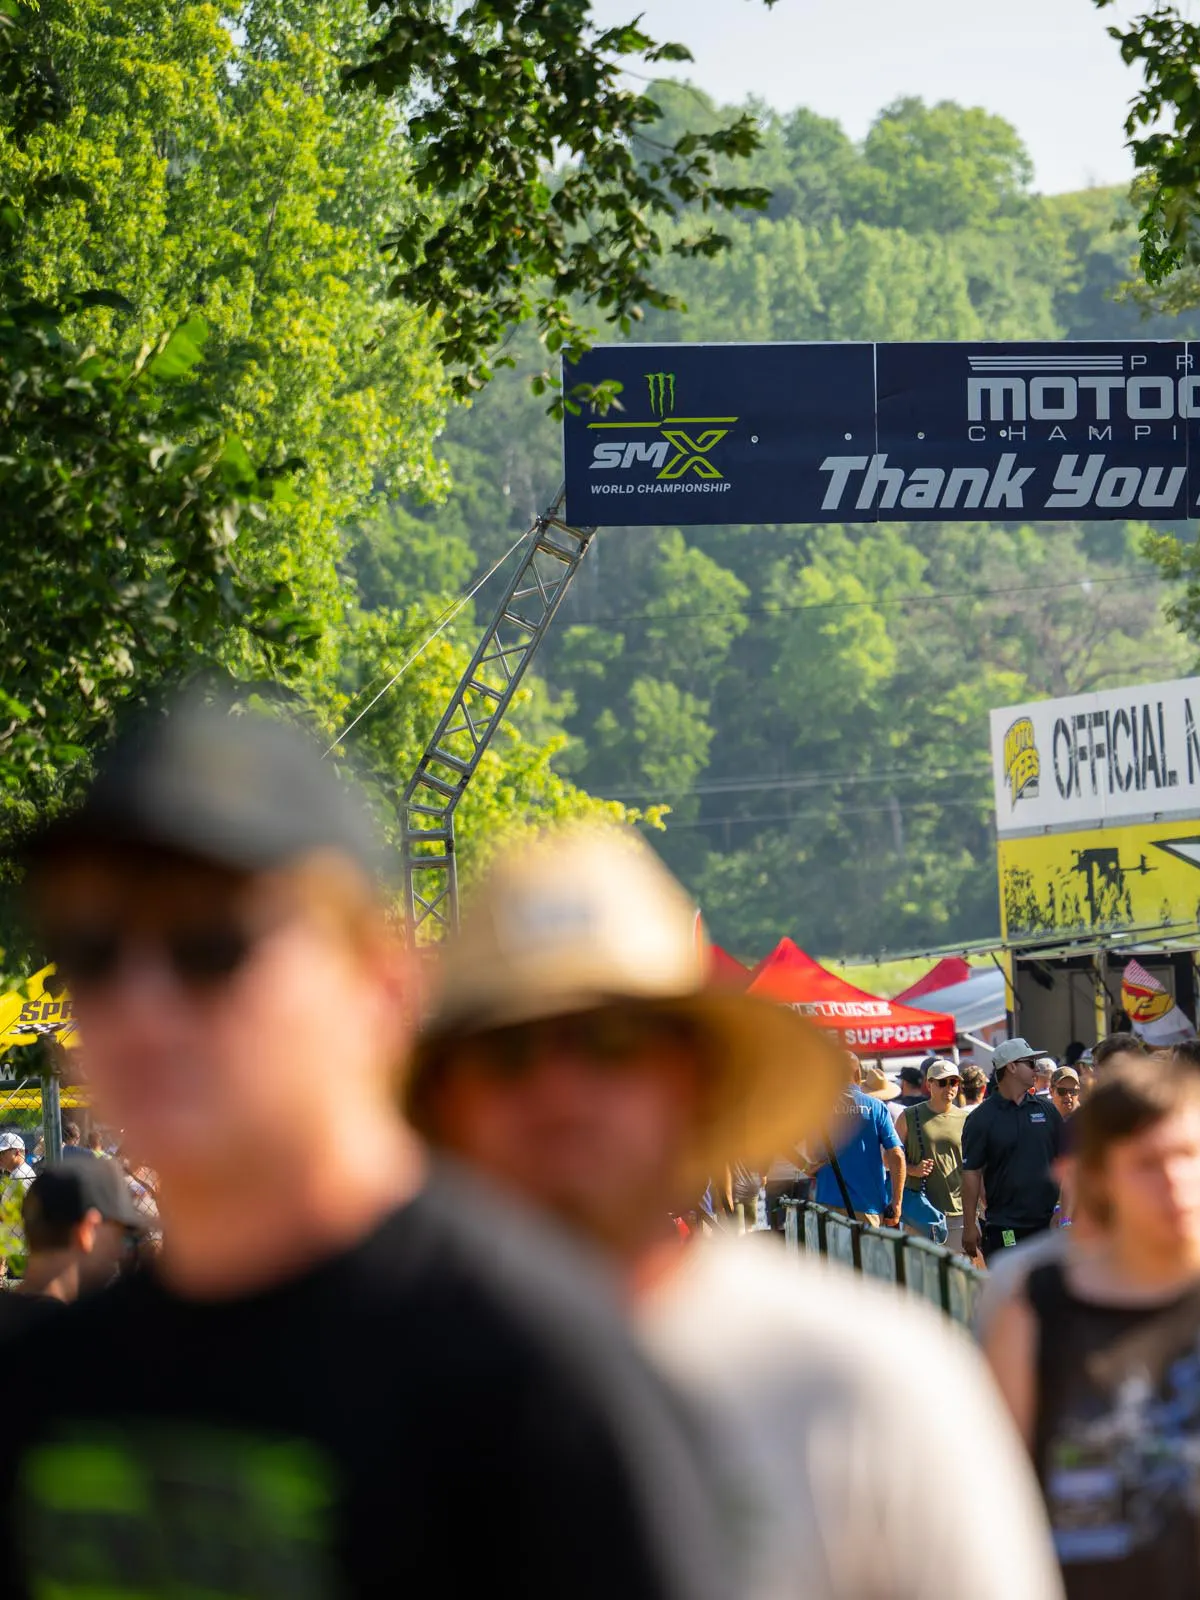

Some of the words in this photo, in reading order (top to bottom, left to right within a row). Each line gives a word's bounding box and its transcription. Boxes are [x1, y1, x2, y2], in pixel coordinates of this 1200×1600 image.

[588, 430, 729, 480] SMX
[818, 453, 1036, 510] Thank
[1044, 454, 1188, 508] You
[591, 484, 635, 495] WORLD
[637, 483, 732, 494] CHAMPIONSHIP
[1003, 718, 1034, 780] MOTO
[1053, 700, 1180, 800] OFFICIAL
[1010, 748, 1040, 808] TEES
[844, 1024, 935, 1045] SUPPORT
